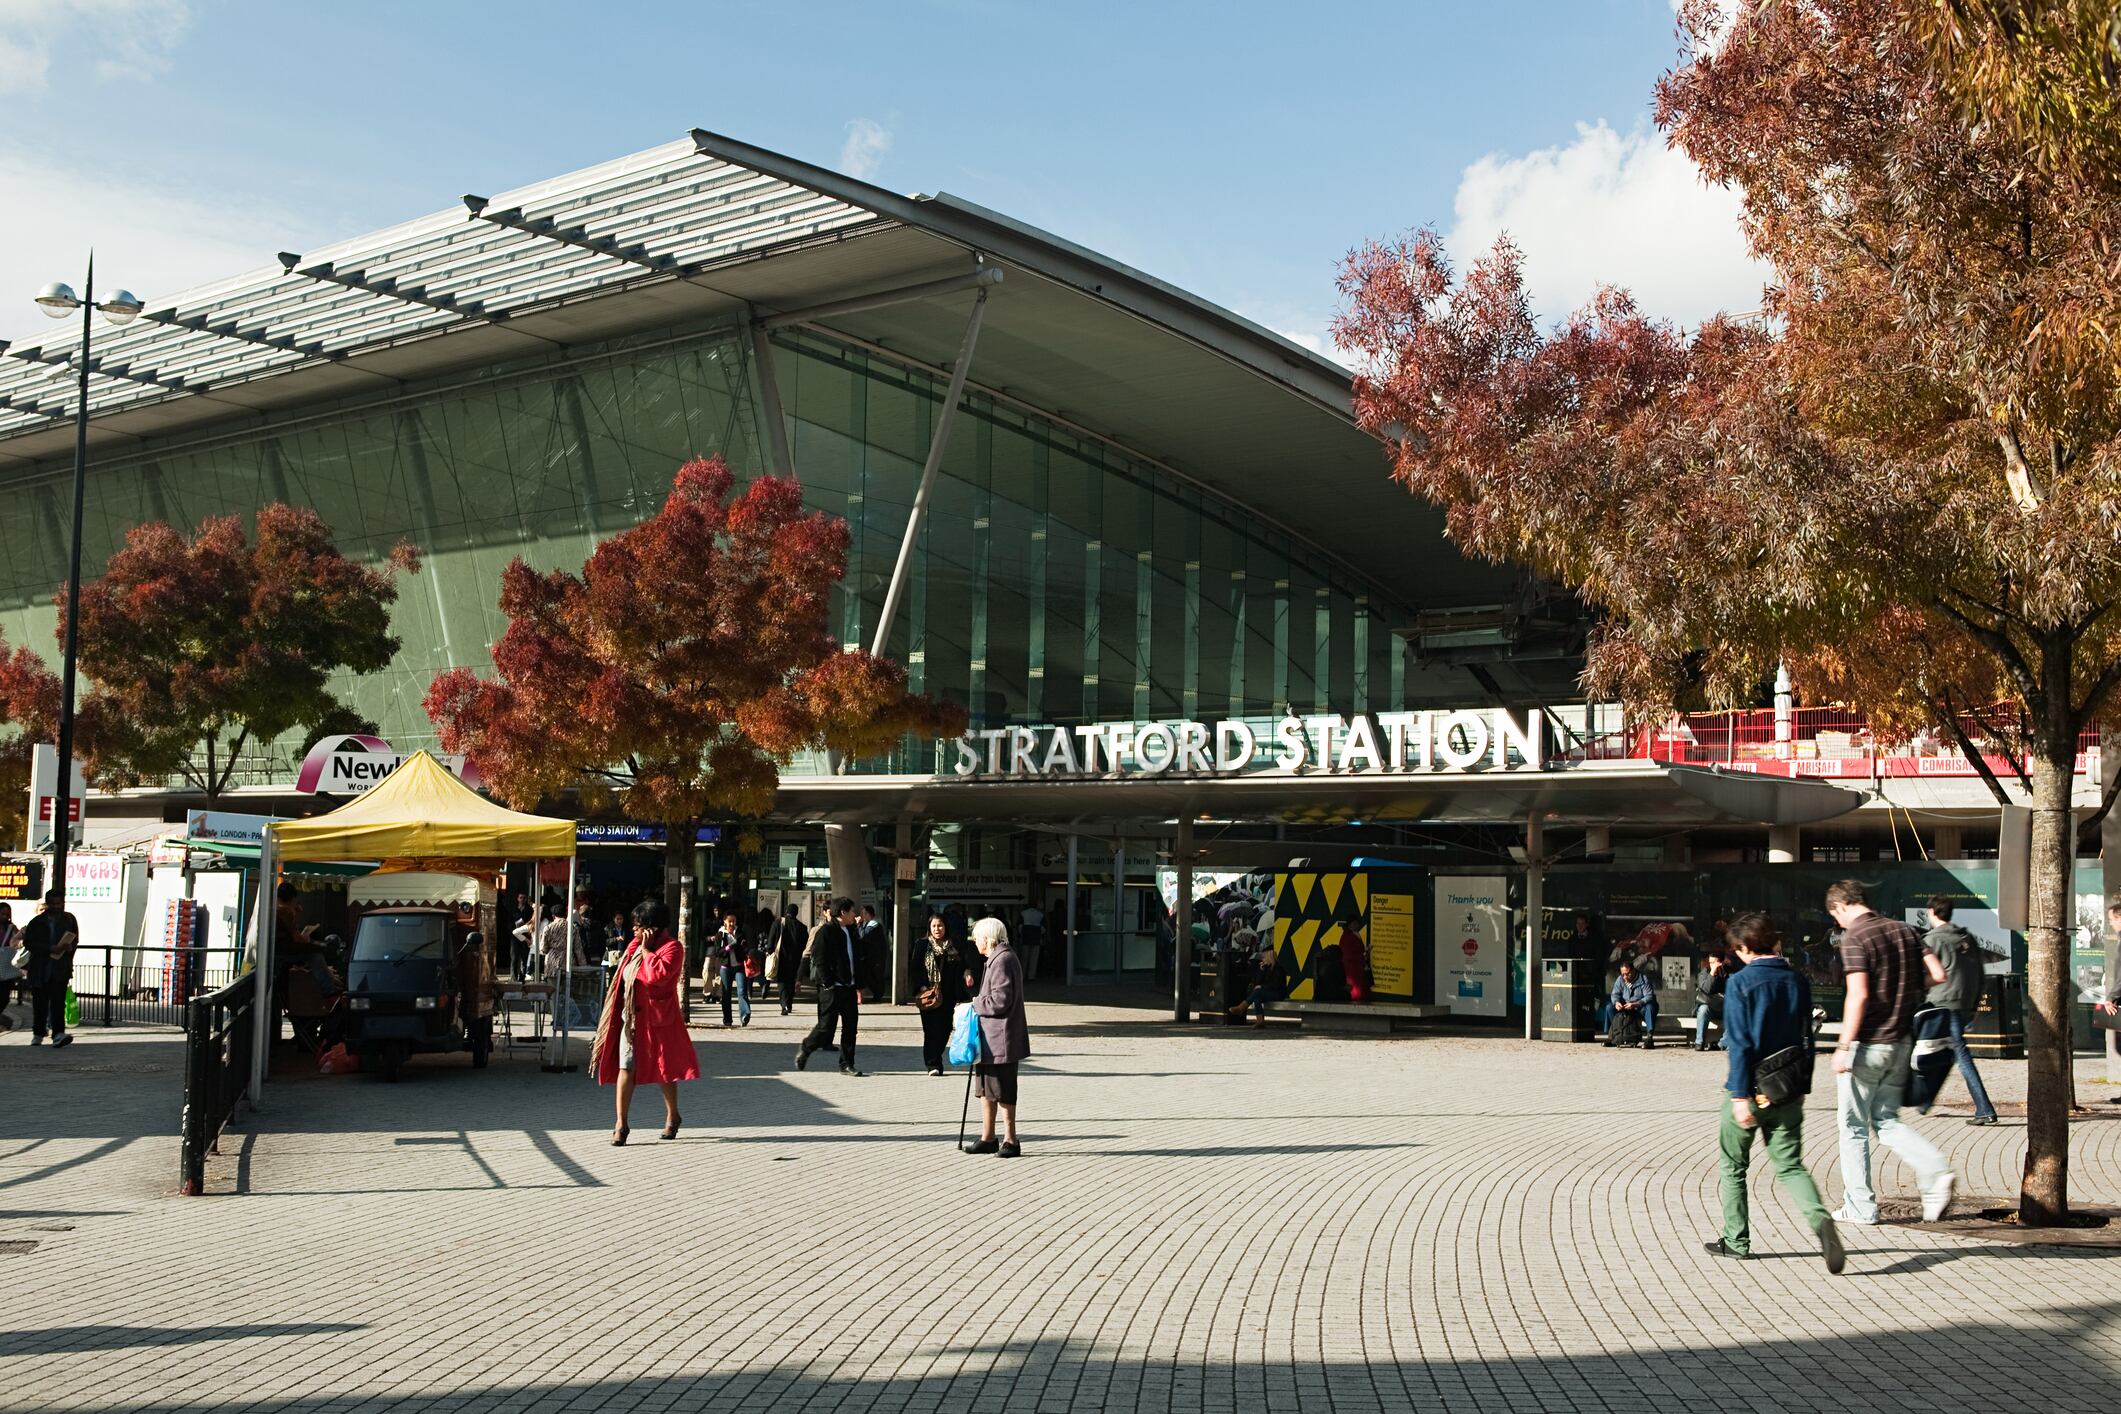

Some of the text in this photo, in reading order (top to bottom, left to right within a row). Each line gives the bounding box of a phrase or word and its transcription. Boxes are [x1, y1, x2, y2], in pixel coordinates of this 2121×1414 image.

[954, 708, 1544, 776] STRATFORD STATION
[221, 829, 247, 838] LONDON
[607, 825, 639, 836] STATION
[1133, 855, 1150, 865] here
[1447, 893, 1494, 906] Thank you
